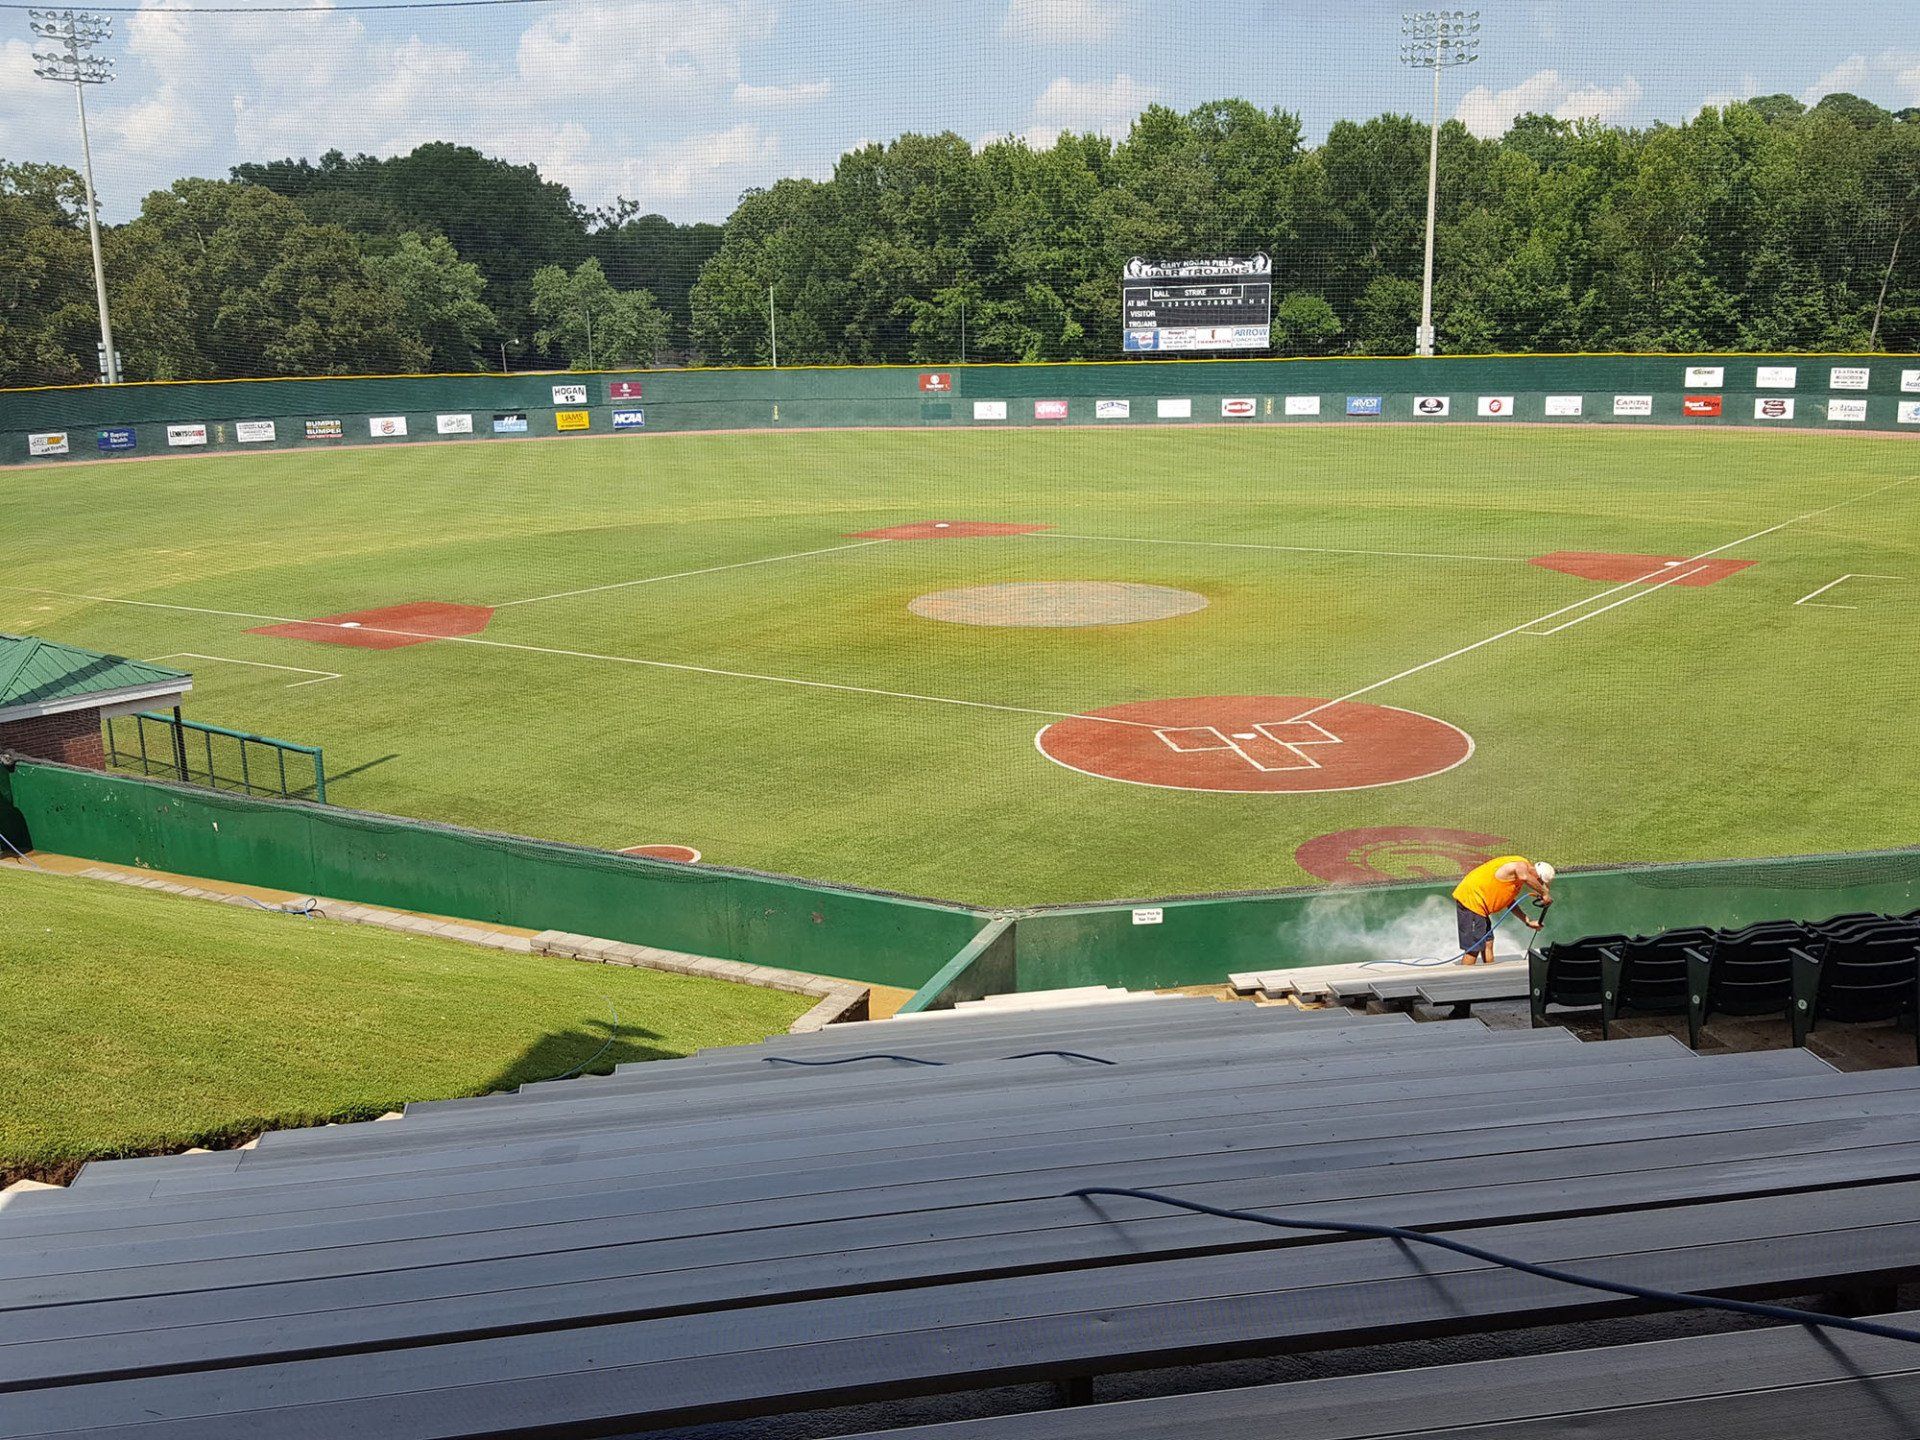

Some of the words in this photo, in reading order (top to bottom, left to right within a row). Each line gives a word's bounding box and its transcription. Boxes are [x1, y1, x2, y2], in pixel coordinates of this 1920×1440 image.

[1184, 267, 1250, 276] TROJANS
[1153, 290, 1170, 298] BALL
[1184, 289, 1207, 297] STRIKE
[1234, 328, 1268, 337] ARROW
[554, 387, 585, 396] HOGAN
[561, 413, 584, 421] UAMS
[614, 412, 643, 424] NCAA
